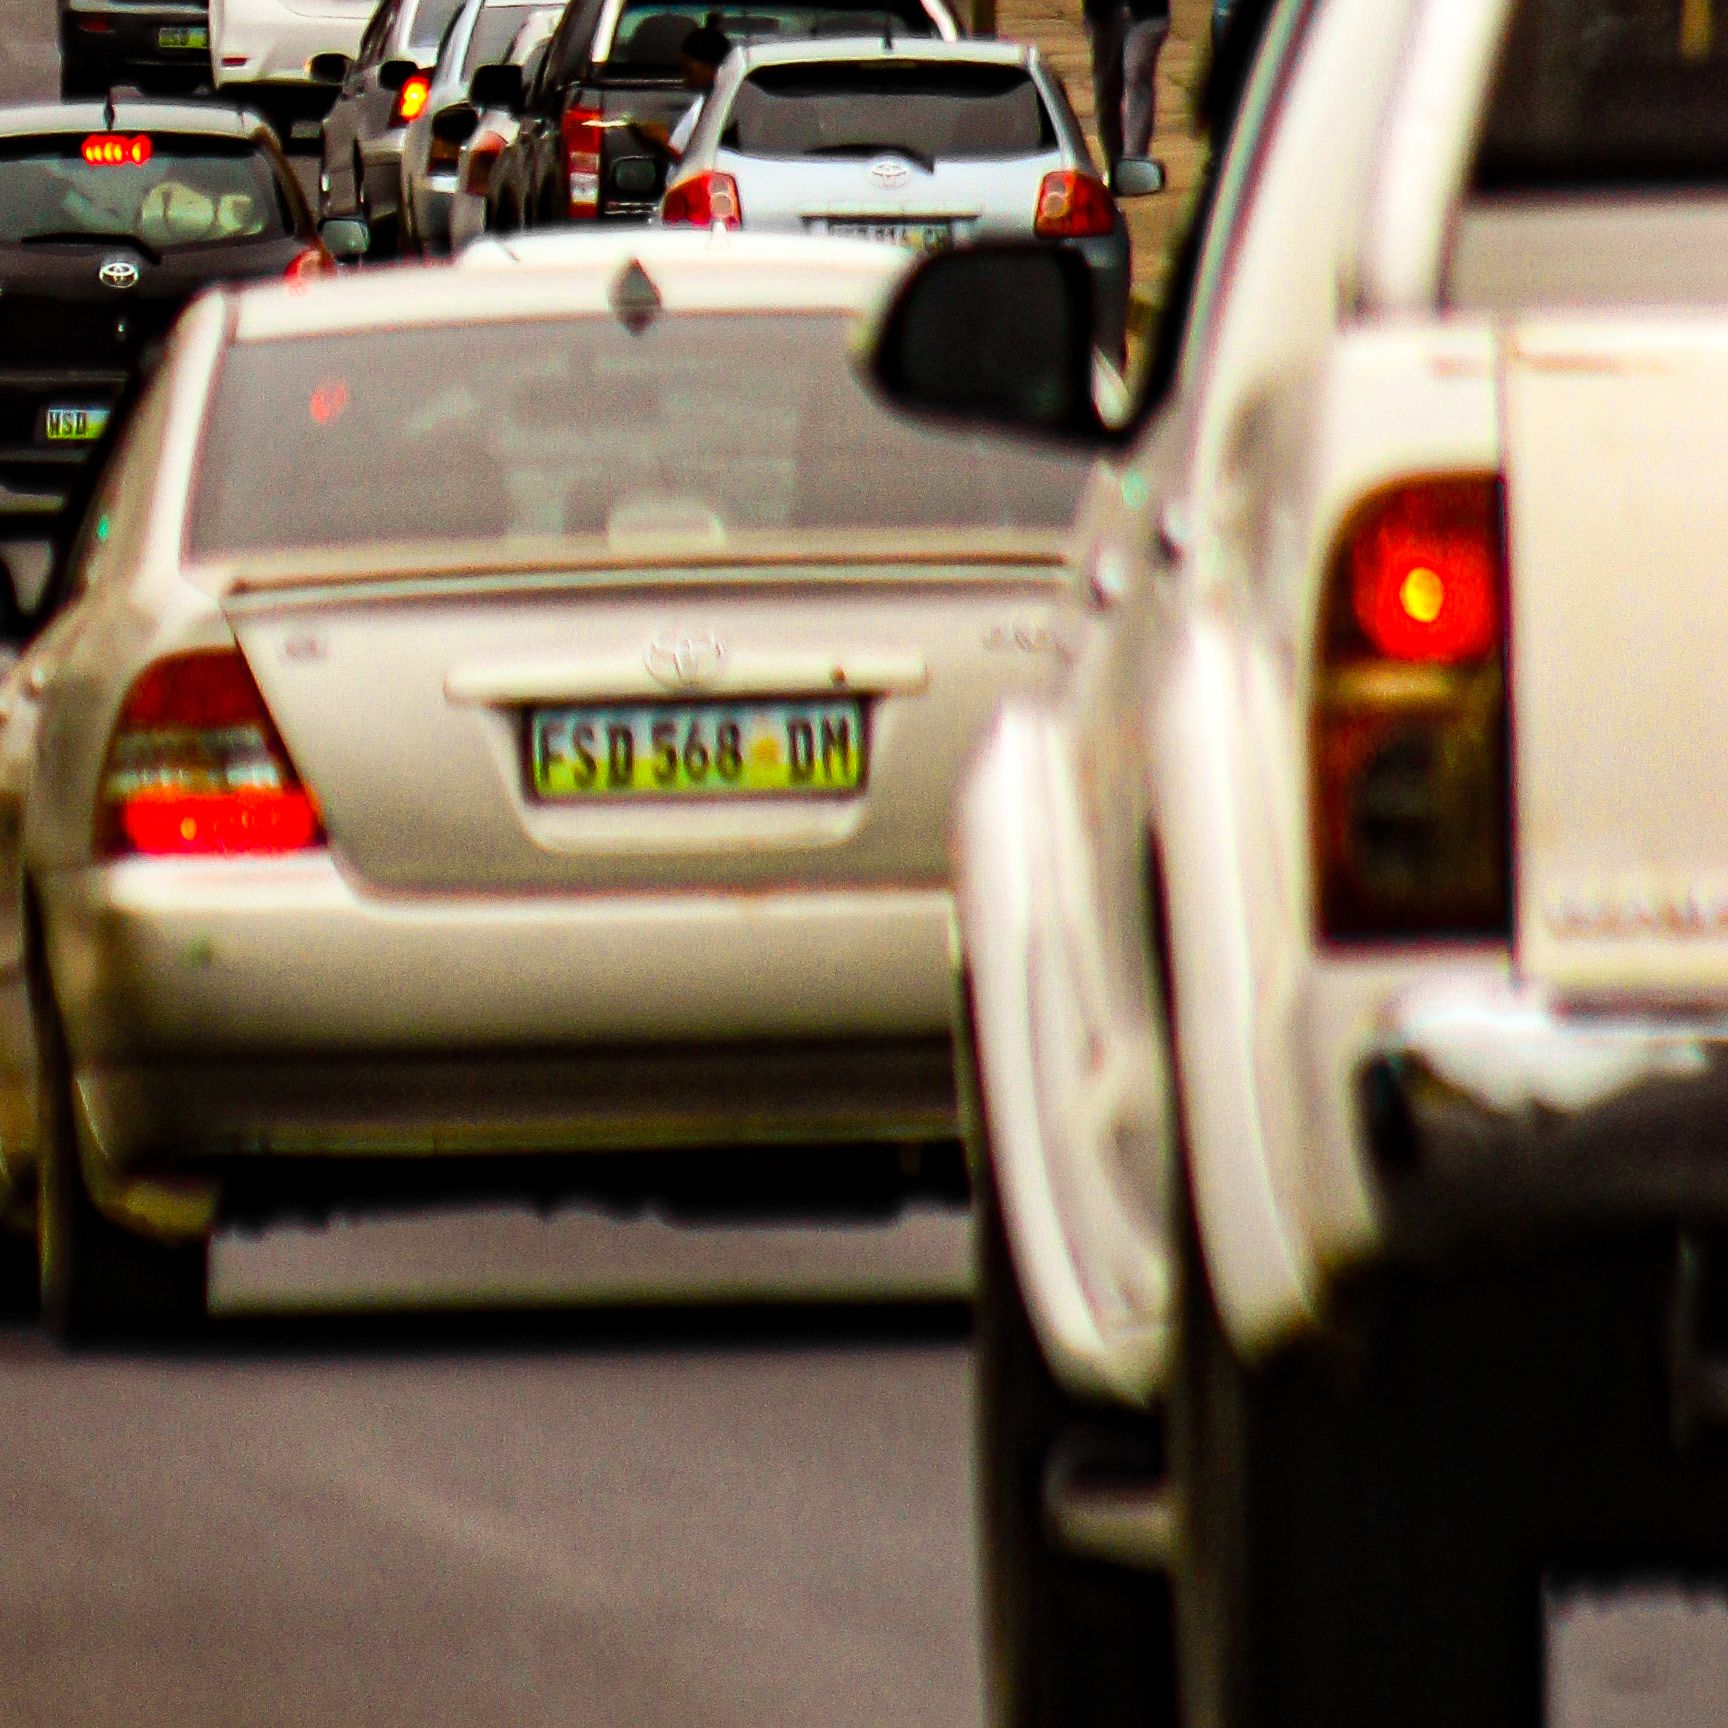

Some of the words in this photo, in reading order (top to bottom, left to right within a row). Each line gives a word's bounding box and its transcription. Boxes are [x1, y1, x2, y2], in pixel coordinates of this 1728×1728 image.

[540, 721, 635, 788] FSD
[651, 718, 744, 786] 568
[787, 715, 850, 782] DM
